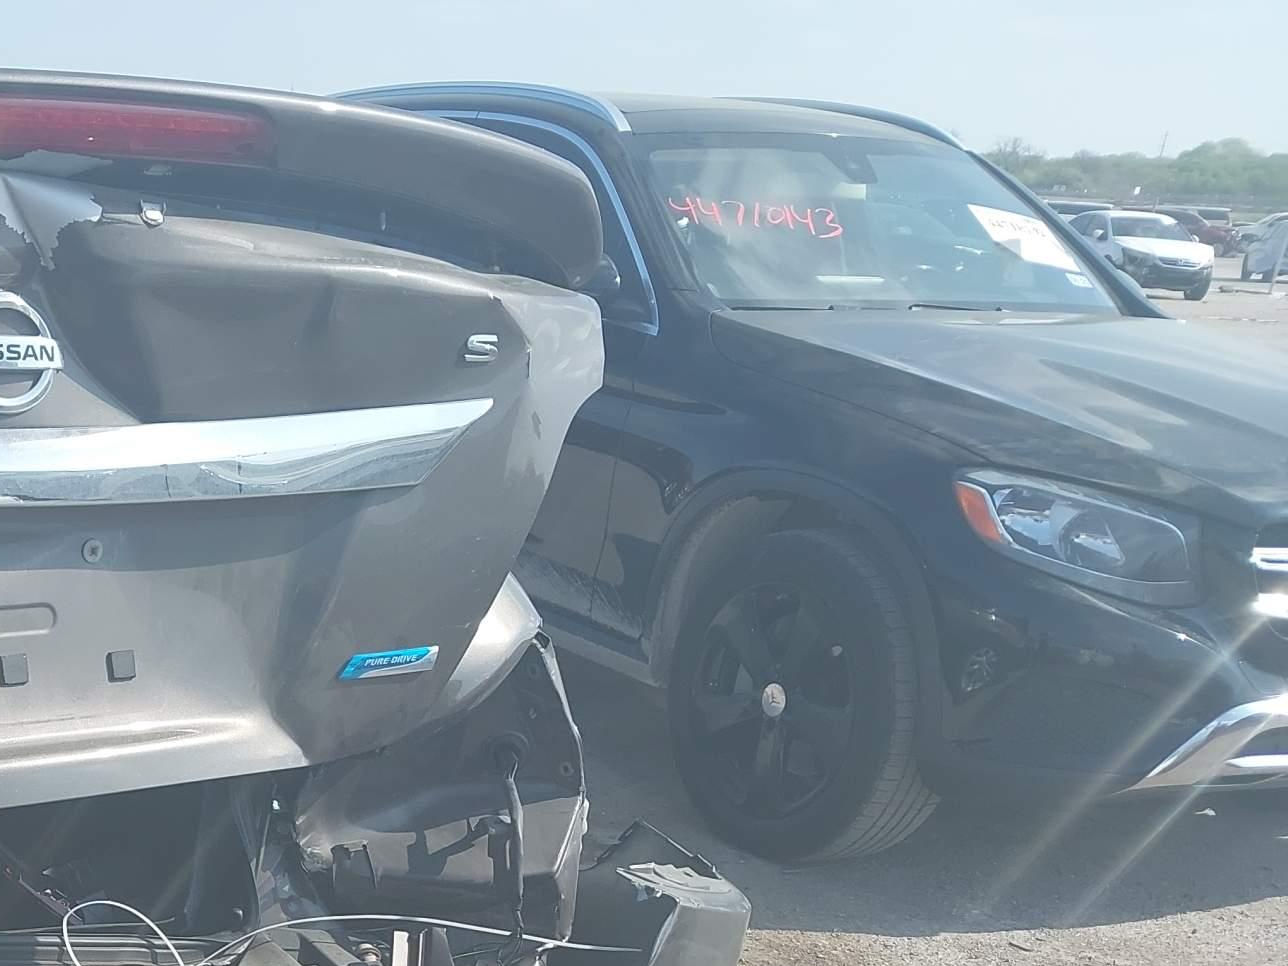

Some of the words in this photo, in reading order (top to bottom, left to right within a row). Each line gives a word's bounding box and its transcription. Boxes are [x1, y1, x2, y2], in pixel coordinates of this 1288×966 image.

[668, 197, 843, 238] 44710143
[464, 334, 498, 362] S
[364, 657, 391, 667] PURE
[391, 655, 417, 665] DRIVE
